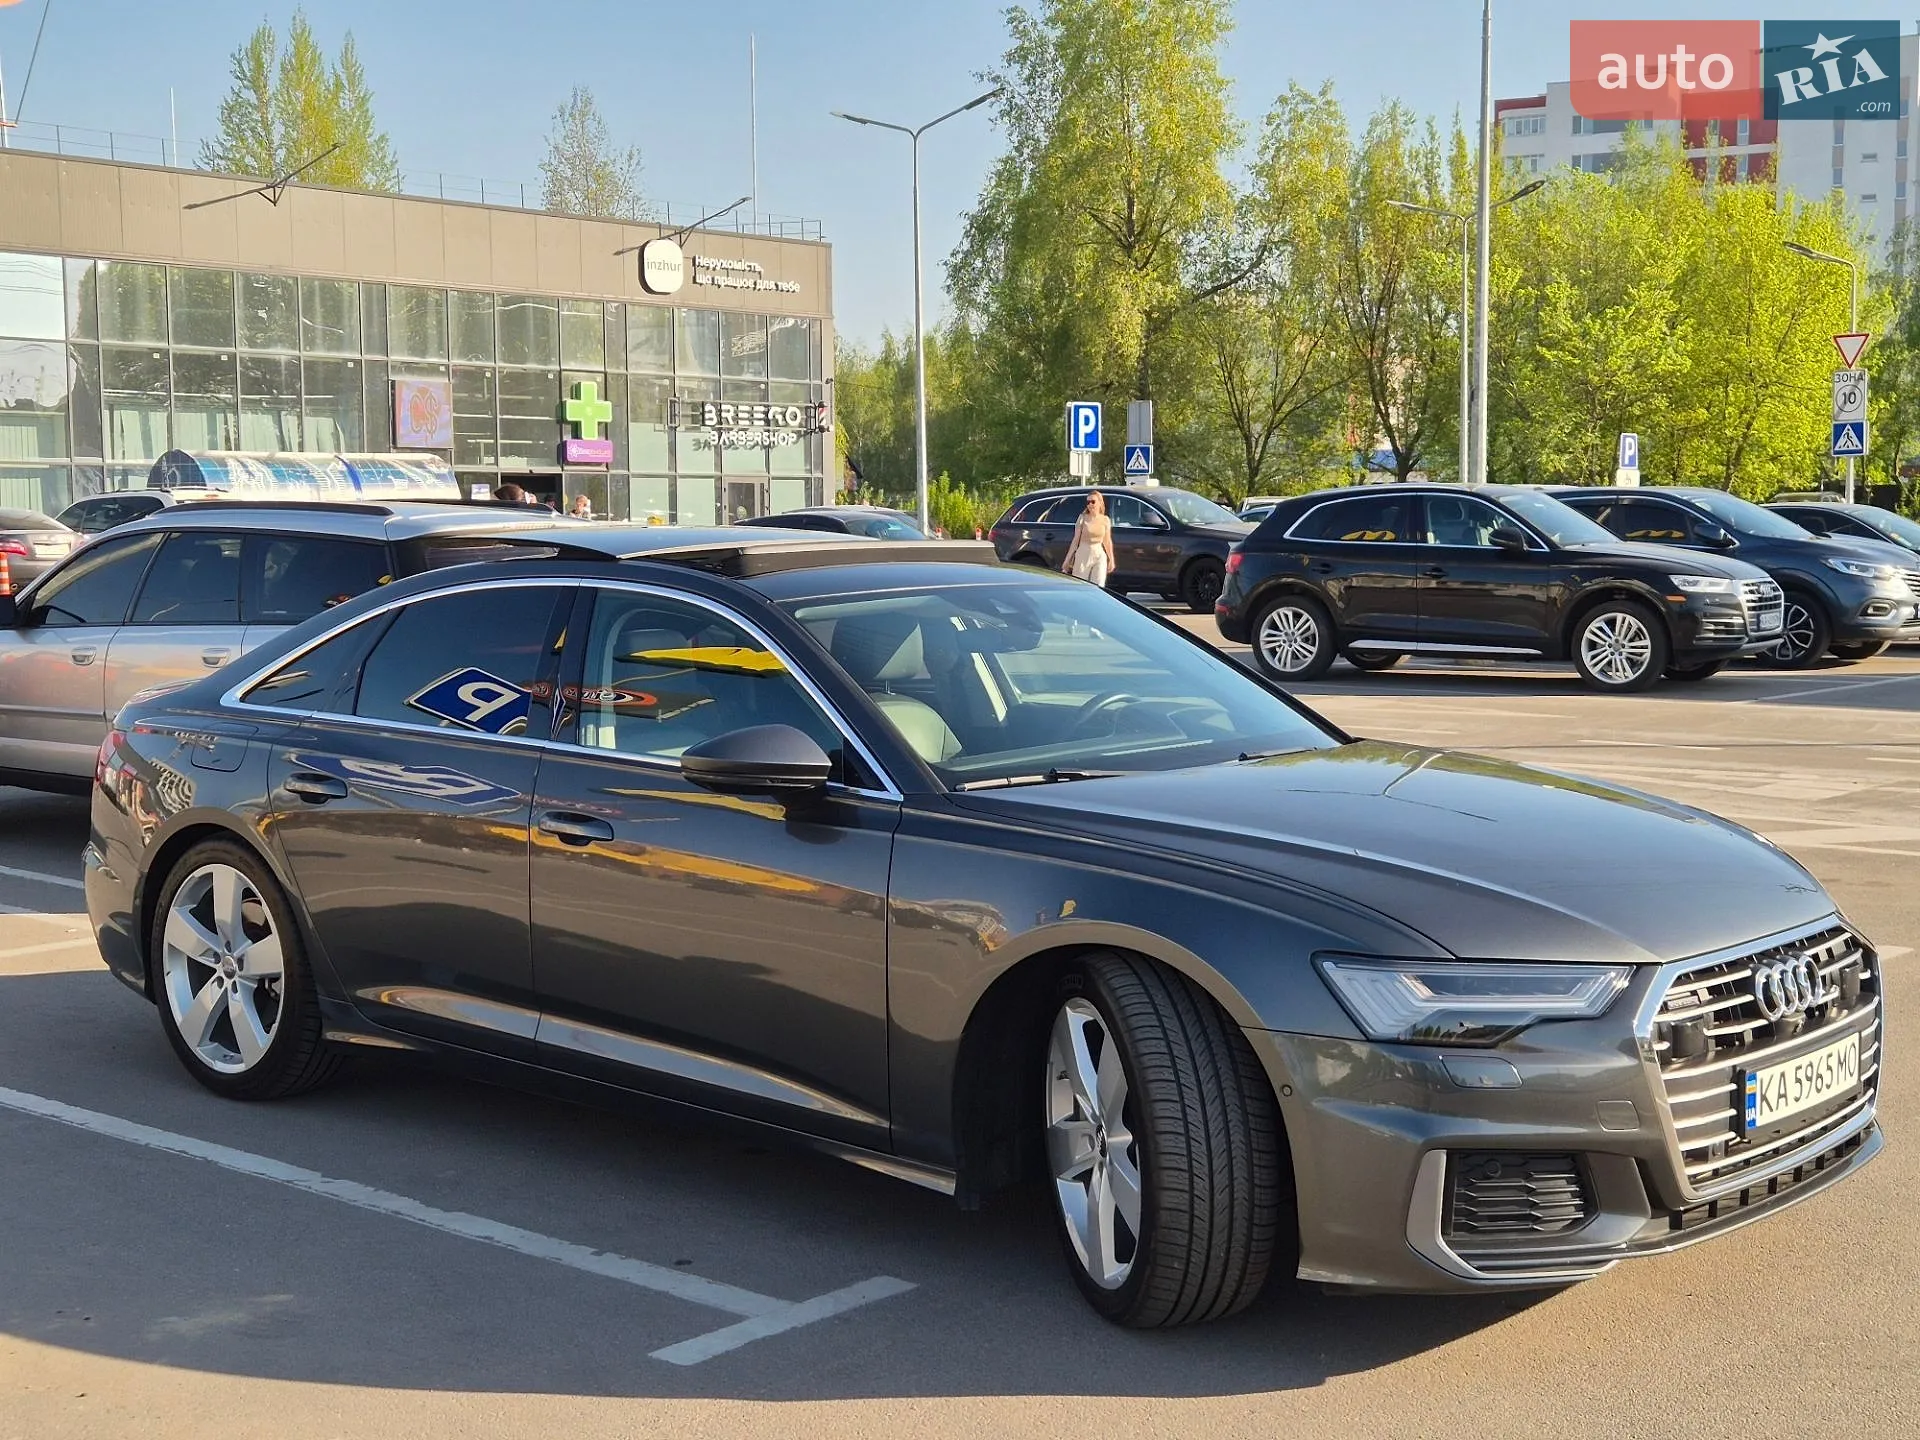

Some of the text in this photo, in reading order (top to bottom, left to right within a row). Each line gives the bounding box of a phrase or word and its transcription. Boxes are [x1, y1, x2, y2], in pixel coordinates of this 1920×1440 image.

[647, 258, 681, 272] inzhur
[695, 255, 764, 272] Нерухомість,
[756, 277, 776, 291] для
[776, 279, 800, 293] тебе
[1835, 373, 1864, 383] ЗОНА
[1842, 391, 1857, 405] 10
[1079, 408, 1096, 447] P
[711, 431, 797, 447] BARBERSHOP
[1625, 437, 1635, 465] P
[1759, 1044, 1857, 1116] KA 5965 MO
[1746, 1107, 1756, 1121] UA
